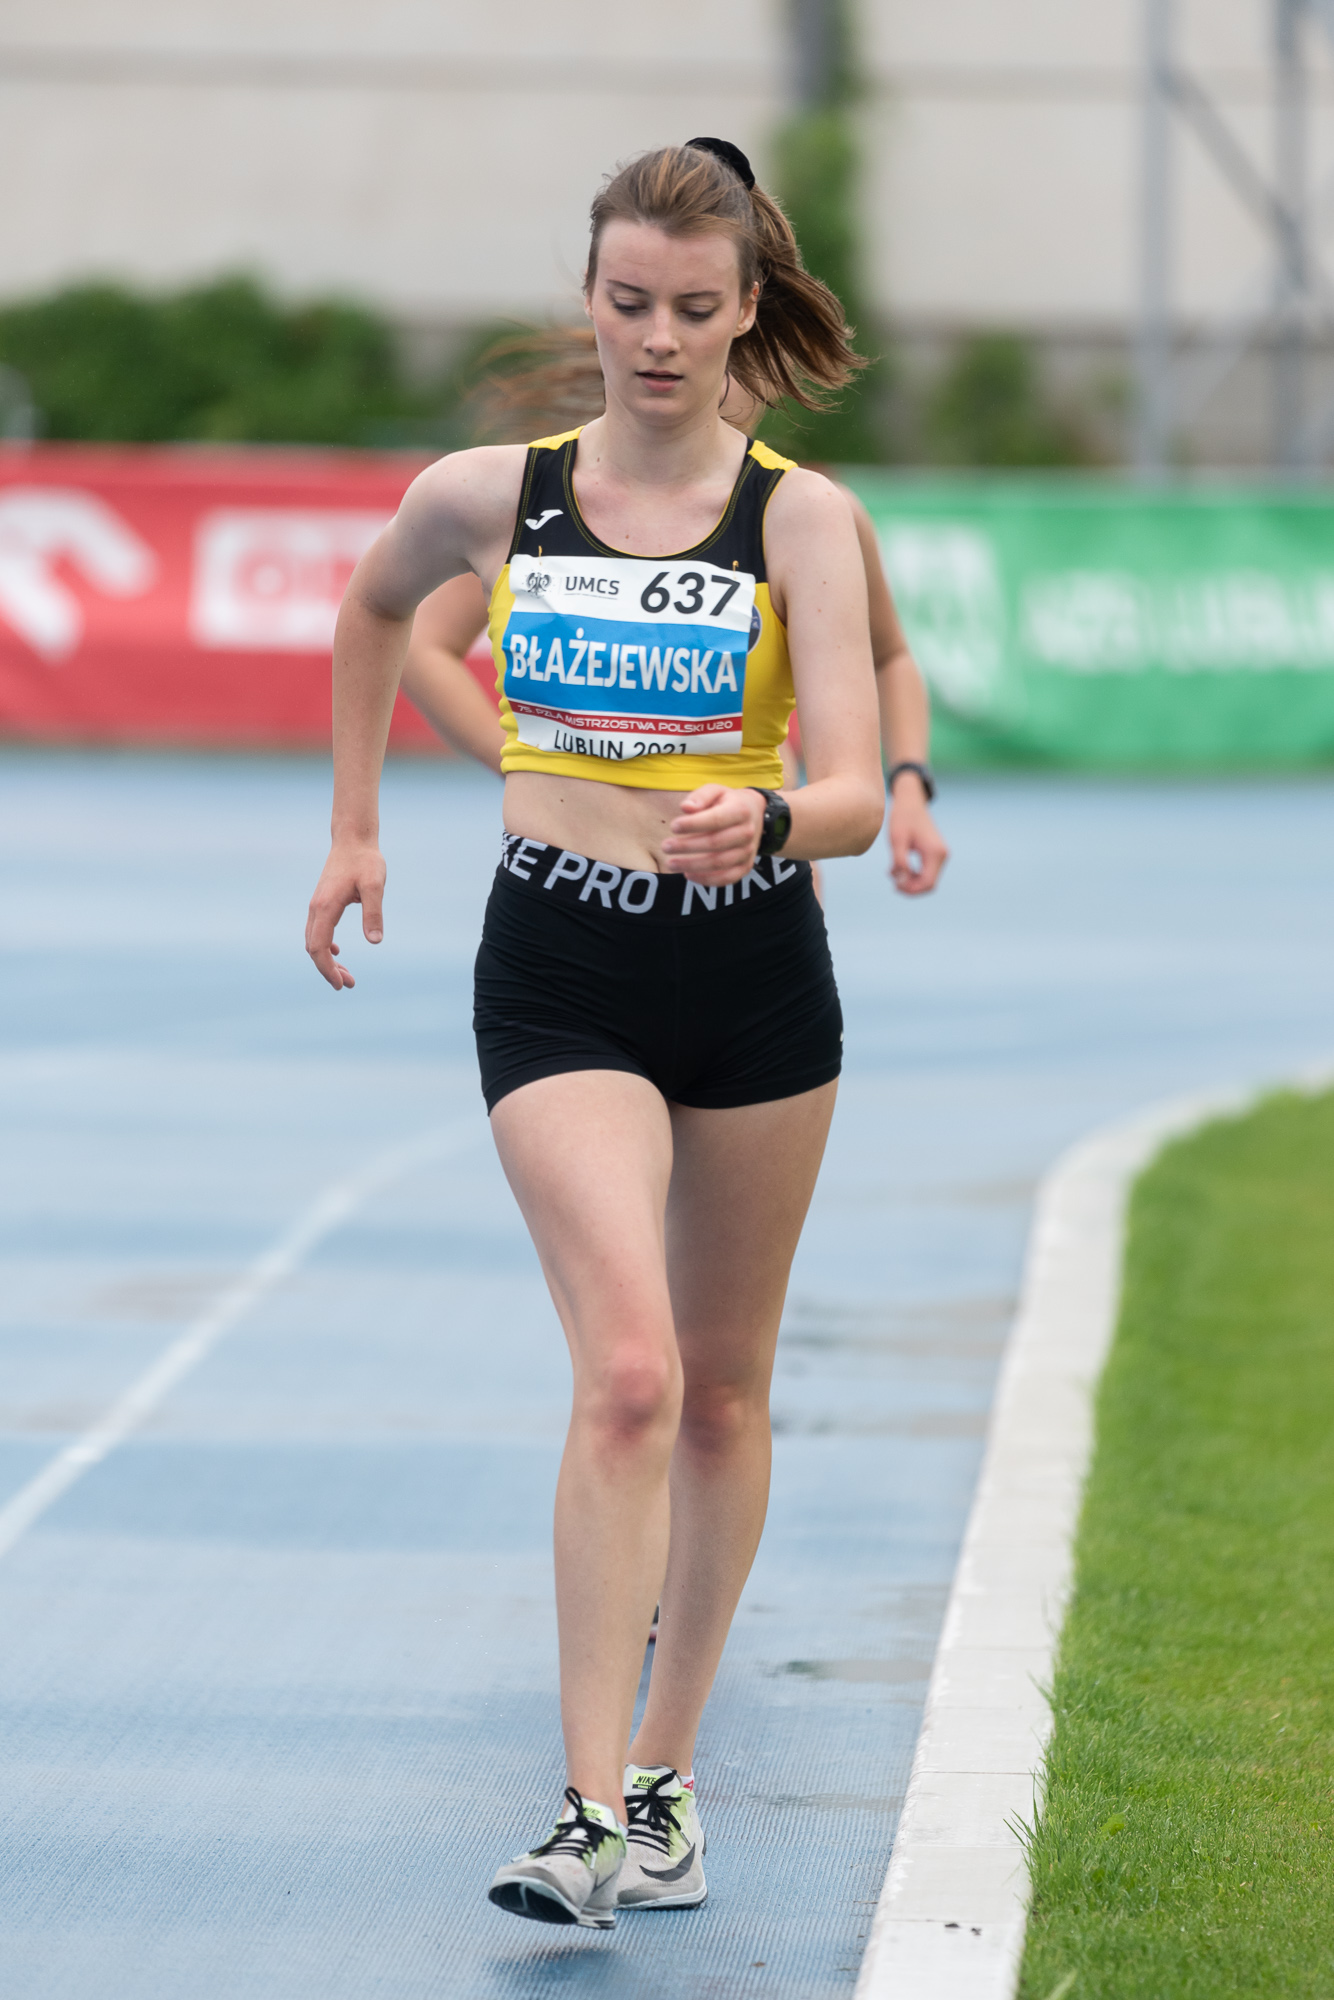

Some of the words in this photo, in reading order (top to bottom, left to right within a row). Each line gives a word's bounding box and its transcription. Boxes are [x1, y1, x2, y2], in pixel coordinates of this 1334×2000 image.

[565, 576, 620, 595] UMCS
[640, 571, 741, 616] 637
[510, 628, 738, 693] BŁAŻEJEWSKA
[535, 708, 564, 721] PZLA
[565, 715, 656, 731] MISTRZOSTWA
[658, 722, 705, 733] POLSKI
[706, 720, 734, 731] U20
[554, 730, 623, 759] LUBLIN
[633, 742, 687, 757] 2021
[543, 849, 659, 915] PRO
